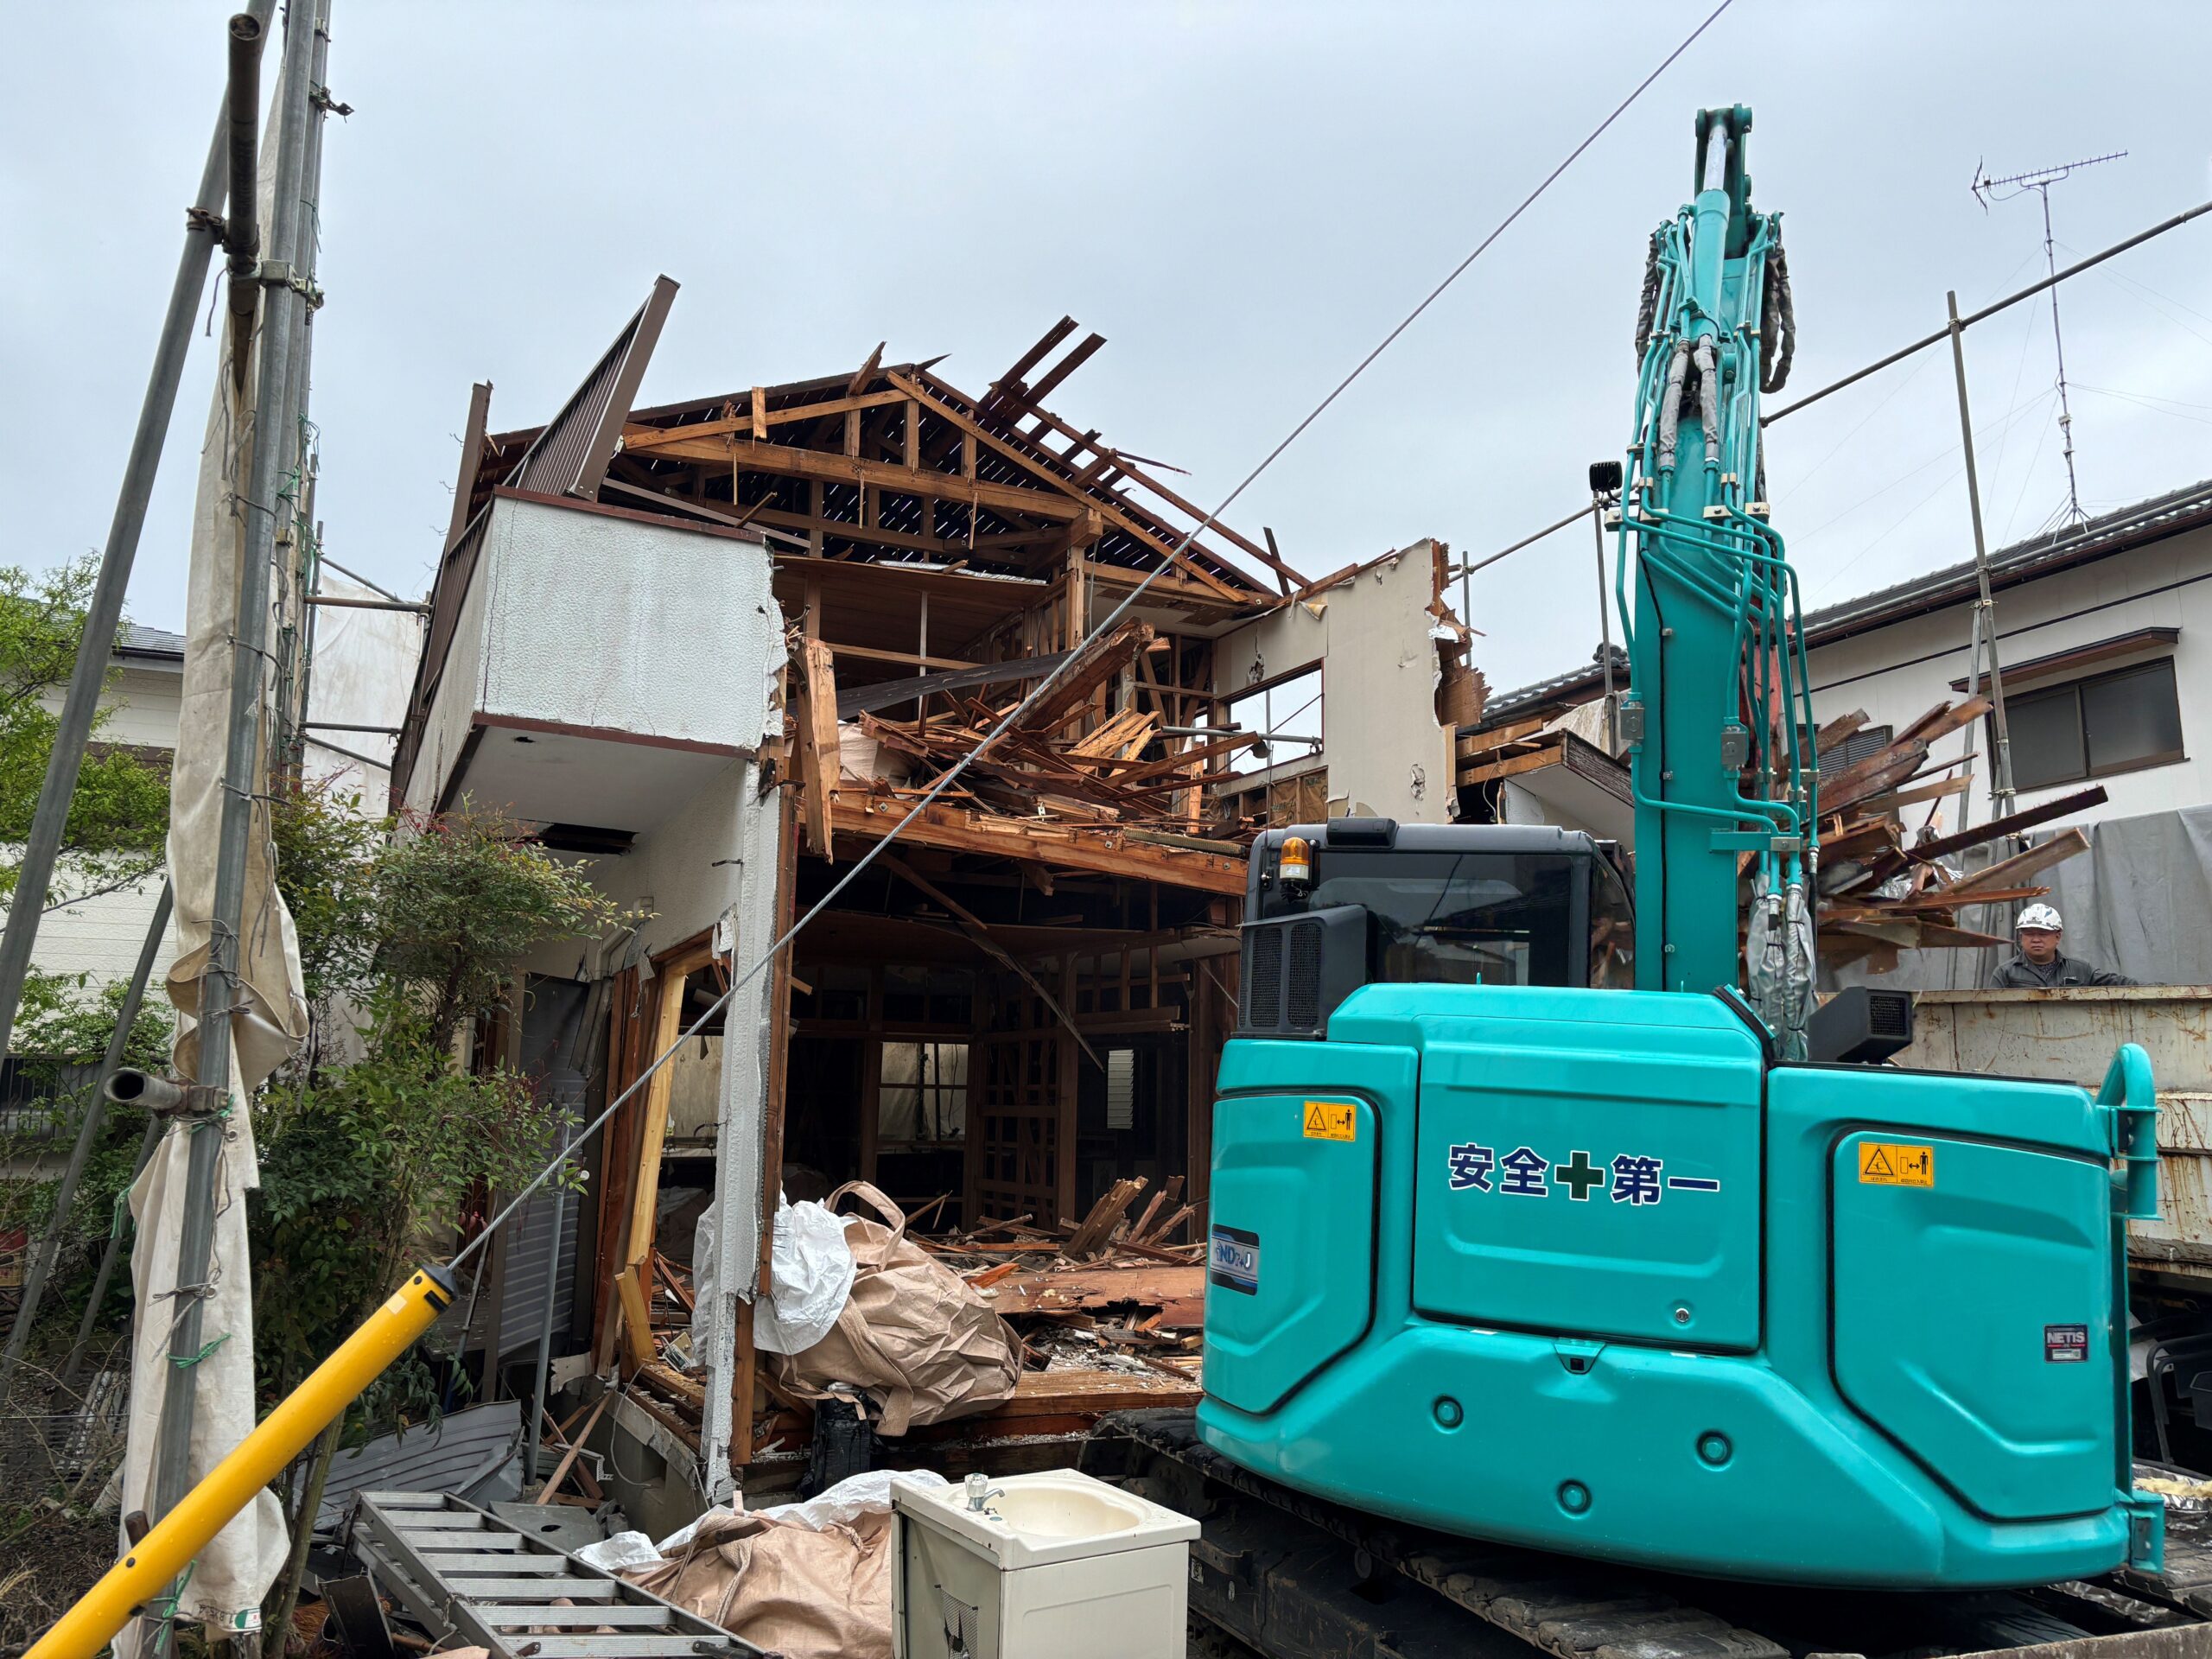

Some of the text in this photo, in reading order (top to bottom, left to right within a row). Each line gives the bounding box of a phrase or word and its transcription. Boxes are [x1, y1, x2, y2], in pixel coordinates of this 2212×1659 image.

[1448, 1142, 1719, 1205] 安全 第一
[2047, 1332, 2085, 1344] NETIS
